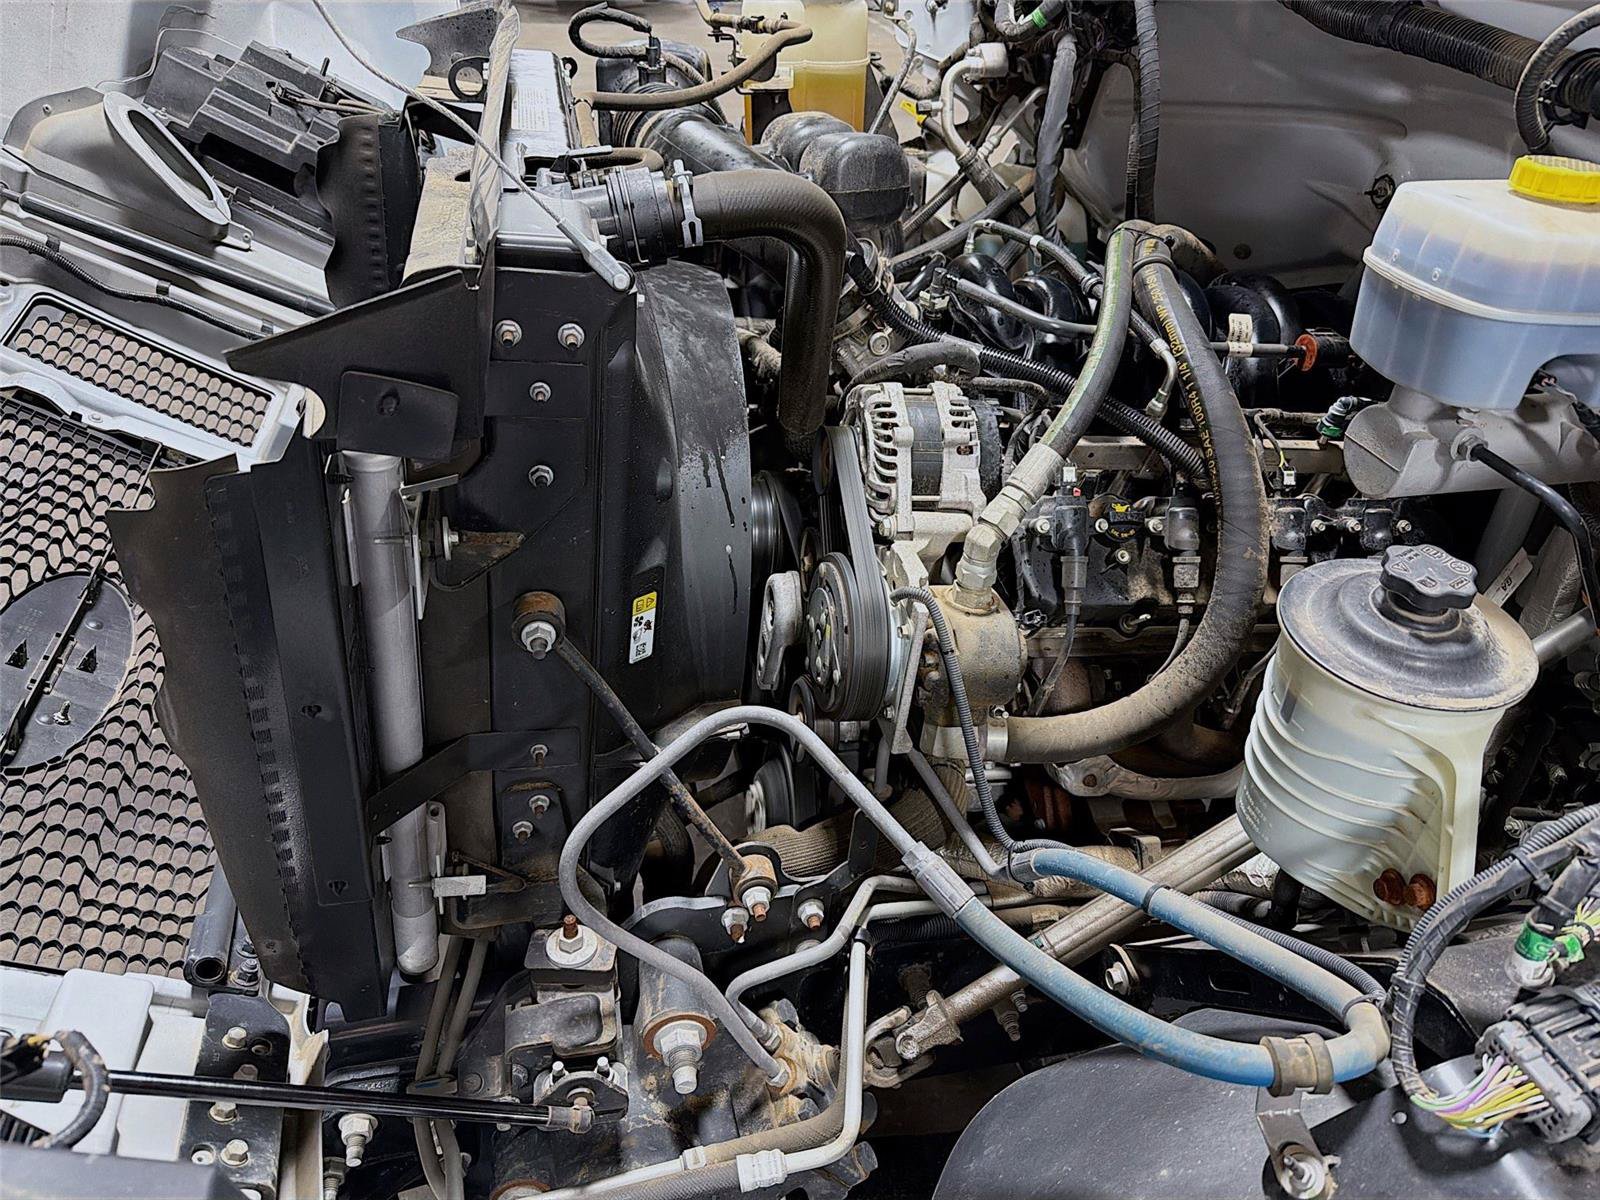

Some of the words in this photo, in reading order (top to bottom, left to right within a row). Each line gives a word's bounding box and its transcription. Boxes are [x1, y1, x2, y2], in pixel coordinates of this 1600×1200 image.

[1146, 274, 1158, 289] PSI
[1151, 288, 1164, 304] 250
[1155, 304, 1169, 321] WP
[1162, 318, 1186, 358] (32mm)
[1185, 381, 1195, 390] 1
[1189, 390, 1206, 428] 100R4
[1201, 430, 1213, 458] SAE
